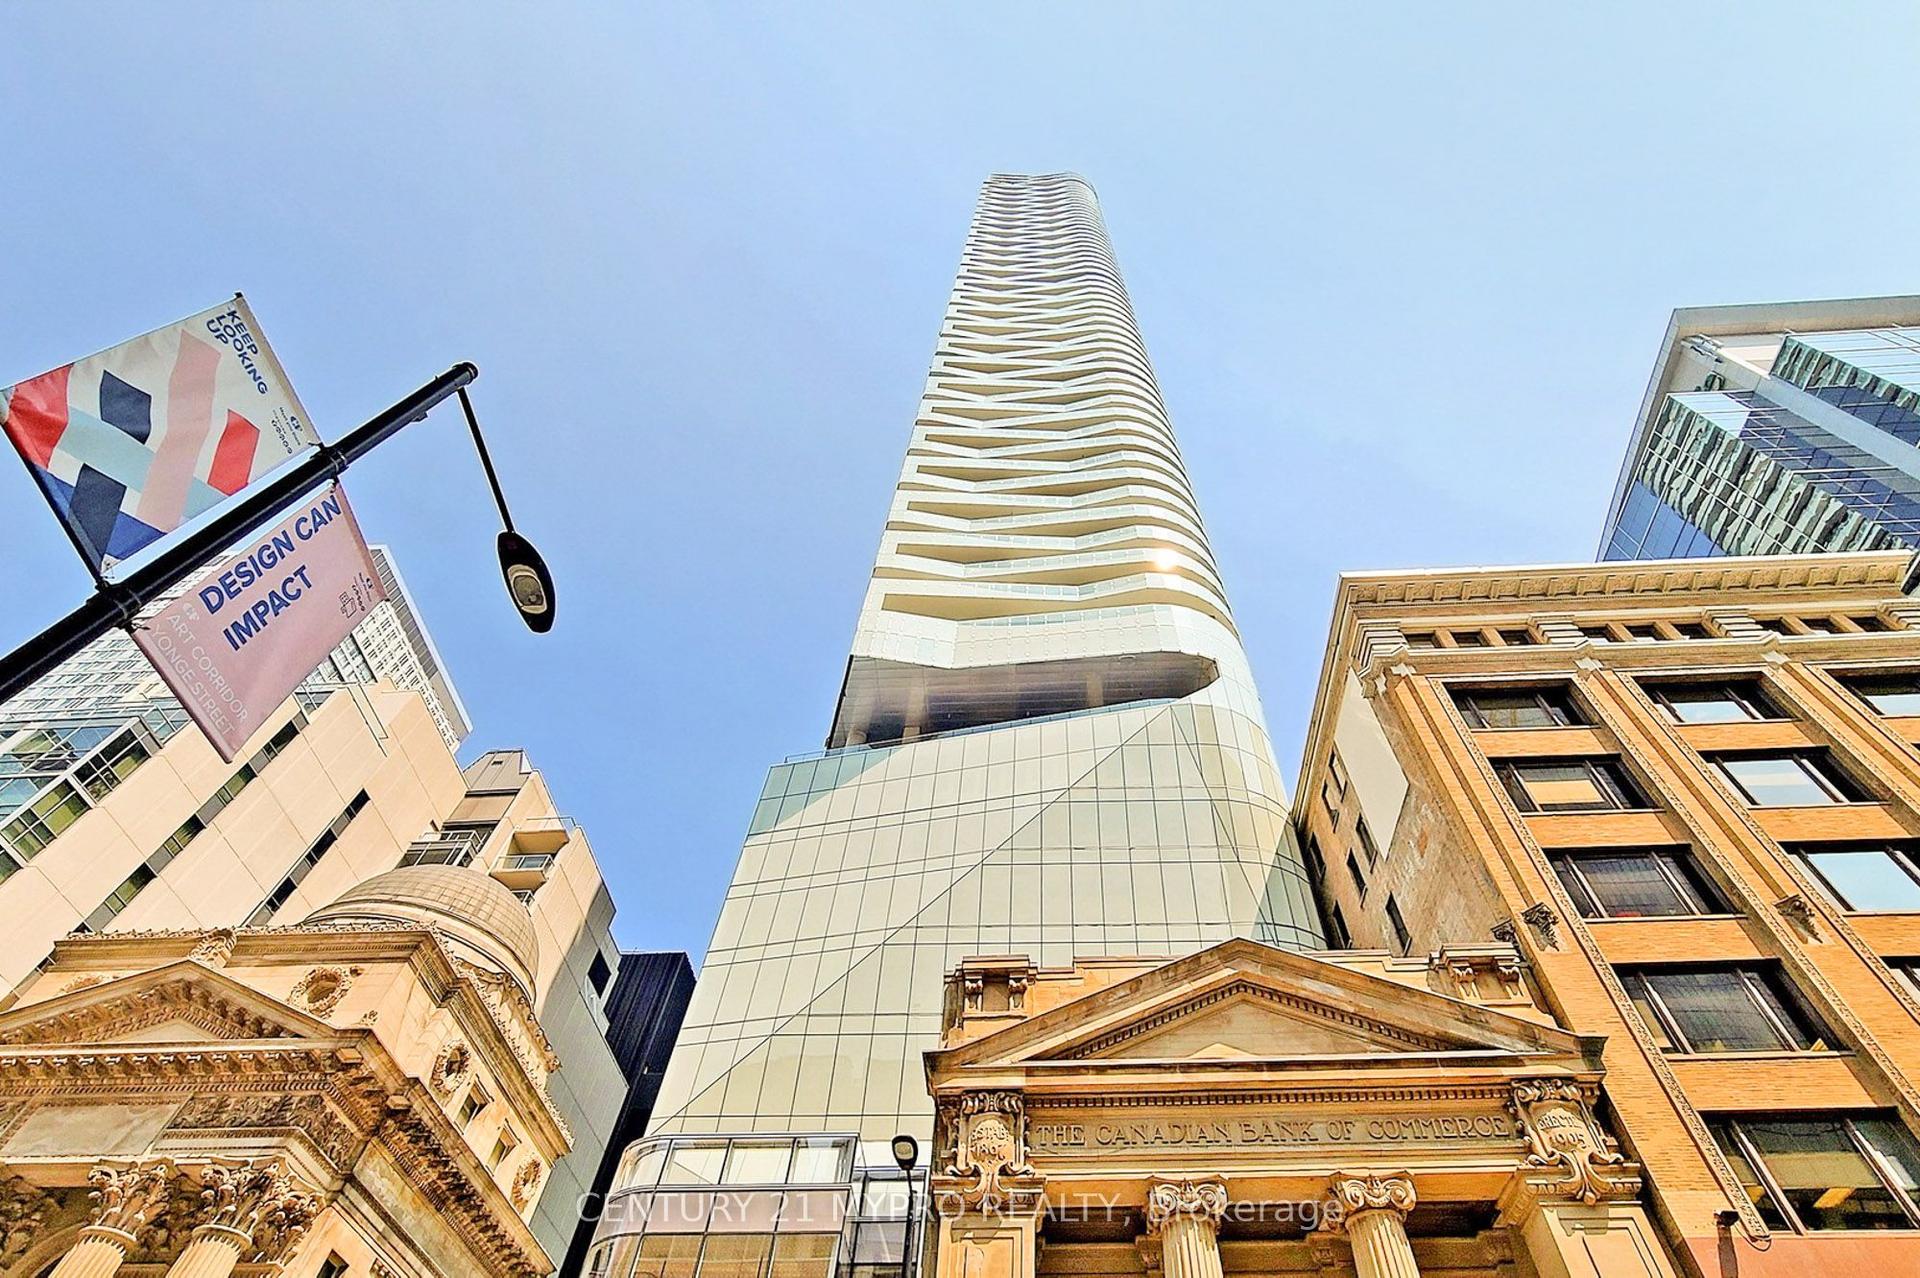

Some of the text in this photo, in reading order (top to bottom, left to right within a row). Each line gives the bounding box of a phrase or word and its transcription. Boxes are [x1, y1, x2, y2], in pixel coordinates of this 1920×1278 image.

[206, 319, 229, 344] UP
[216, 315, 268, 394] LOOKING
[227, 310, 258, 354] KEEP
[199, 530, 296, 615] DESIGN
[294, 494, 342, 541] CAN
[223, 565, 313, 651] IMPACT
[152, 624, 235, 735] YONGE STREET
[167, 614, 248, 720] ART CORRIDOR
[1036, 1115, 1510, 1146] THE CANADIAN BANK OF COMMERCE
